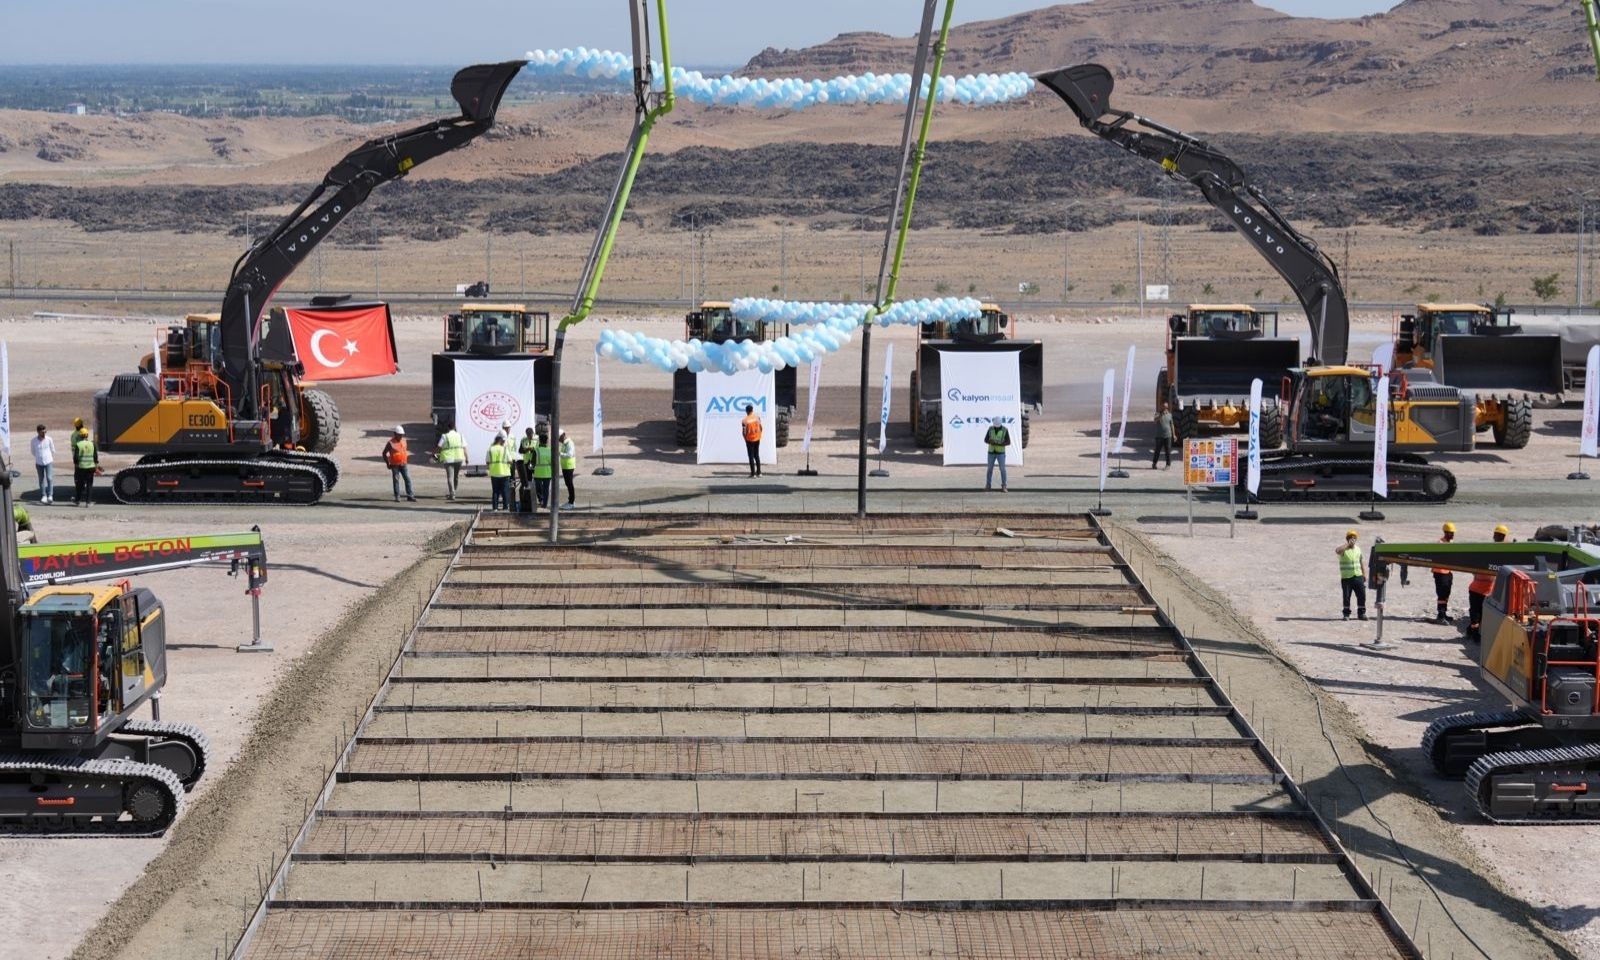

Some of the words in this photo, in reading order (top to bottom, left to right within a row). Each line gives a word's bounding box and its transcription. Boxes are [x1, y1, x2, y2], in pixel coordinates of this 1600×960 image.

[287, 205, 341, 252] VOLVO
[1234, 205, 1284, 254] VOLVO
[705, 396, 767, 412] AYGM
[188, 414, 216, 427] EC300
[114, 536, 192, 562] BETON
[29, 570, 66, 581] ZOOMLION
